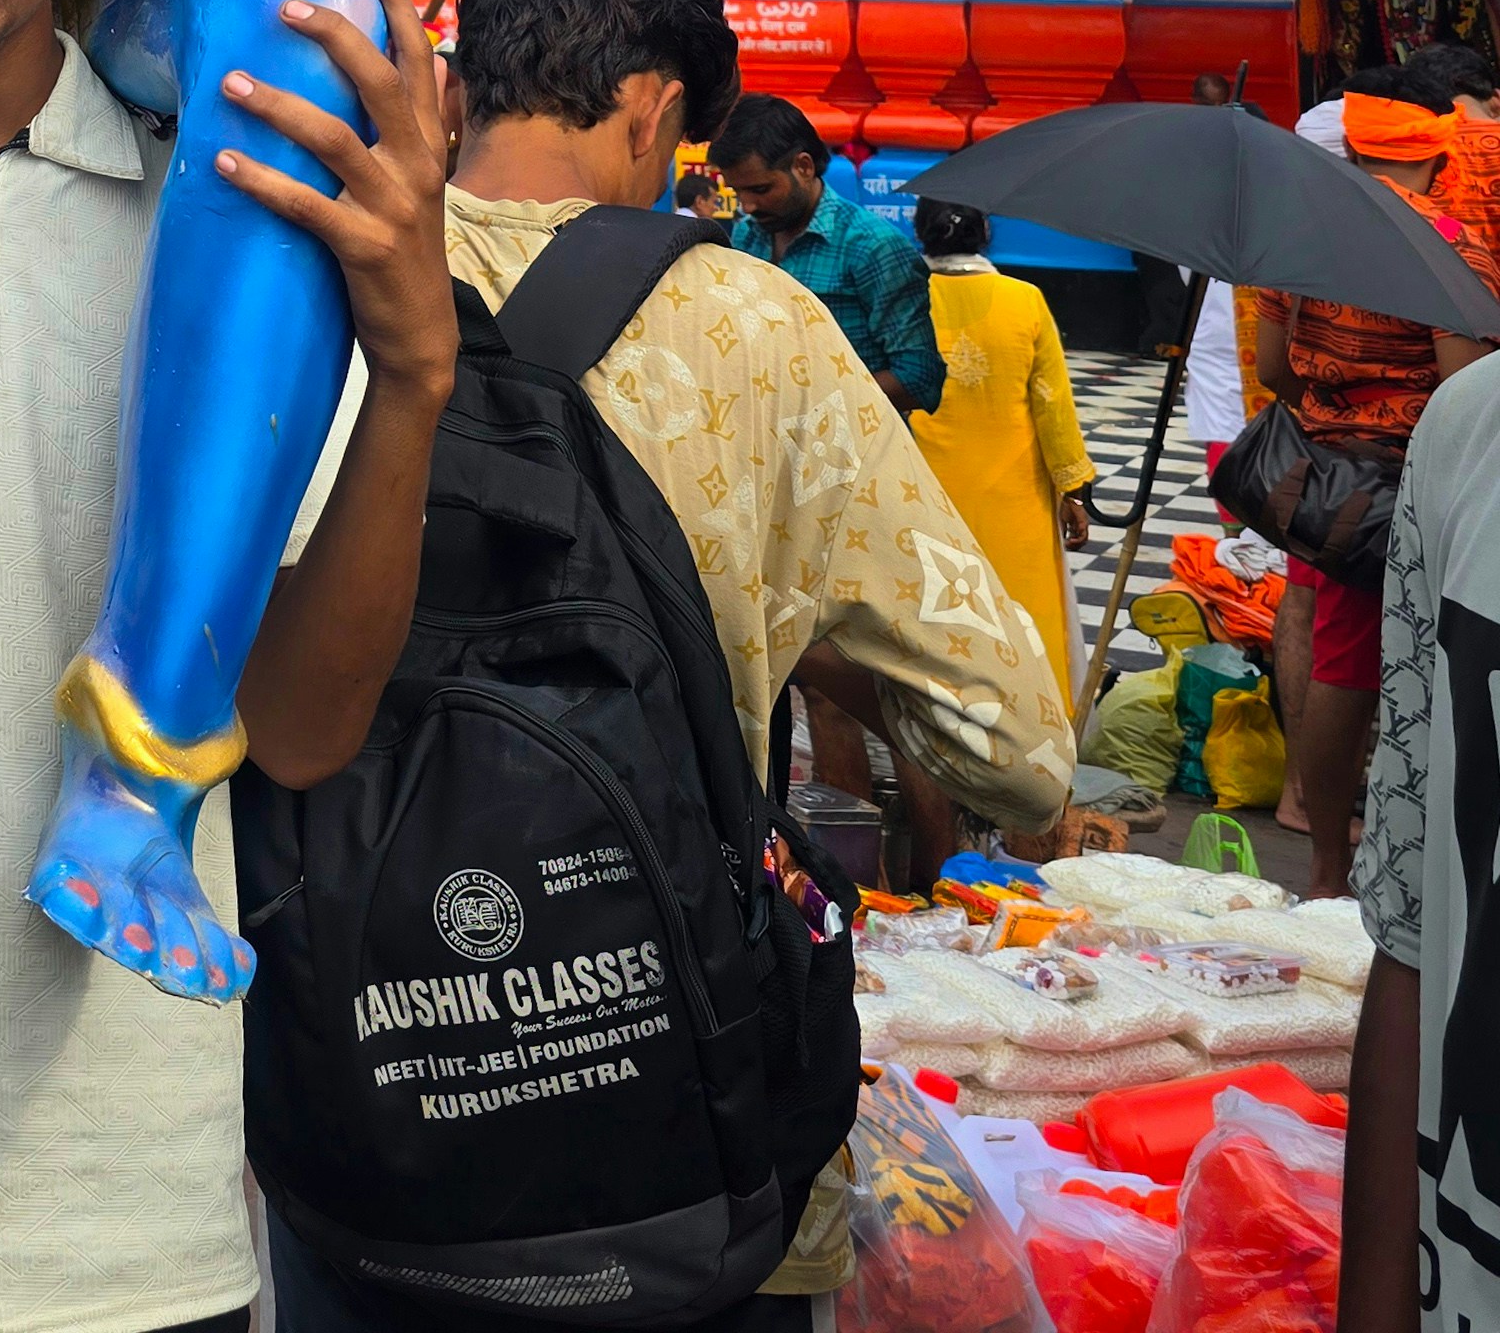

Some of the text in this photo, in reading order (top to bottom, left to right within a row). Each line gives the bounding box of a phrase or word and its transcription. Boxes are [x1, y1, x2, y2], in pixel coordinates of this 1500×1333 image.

[471, 873, 517, 913] CLASSES
[446, 921, 519, 957] KURUKSHETRA
[354, 941, 666, 1042] KAUSHIK CLASSES
[546, 1014, 592, 1031] Success
[596, 1004, 618, 1019] Our
[419, 1057, 640, 1120] KURUKSHETRA
